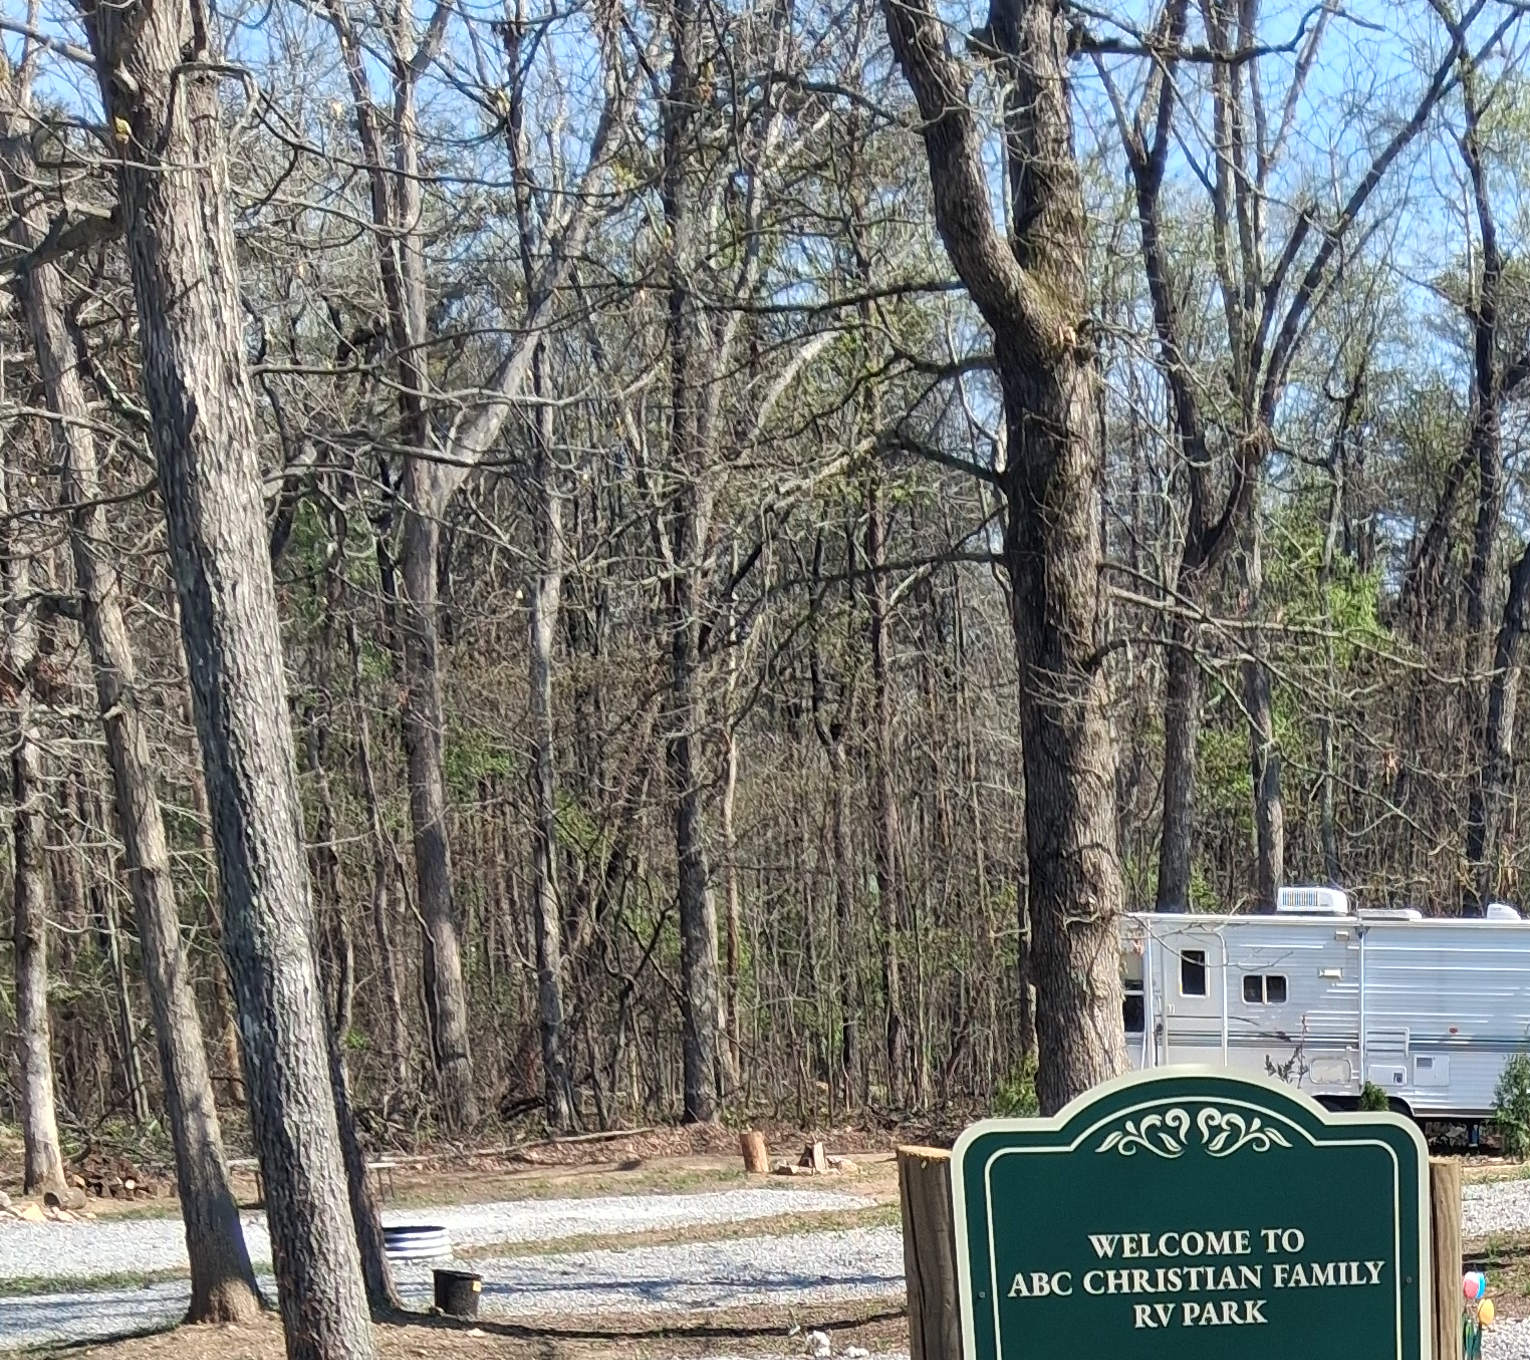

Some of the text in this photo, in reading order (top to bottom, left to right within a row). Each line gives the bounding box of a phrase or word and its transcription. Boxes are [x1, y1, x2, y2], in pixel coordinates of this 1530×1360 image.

[1087, 1228, 1305, 1259] WELCOME TO
[1007, 1260, 1385, 1298] ABC CHRISTIAN FAMILY
[1133, 1299, 1268, 1329] RV PARK
